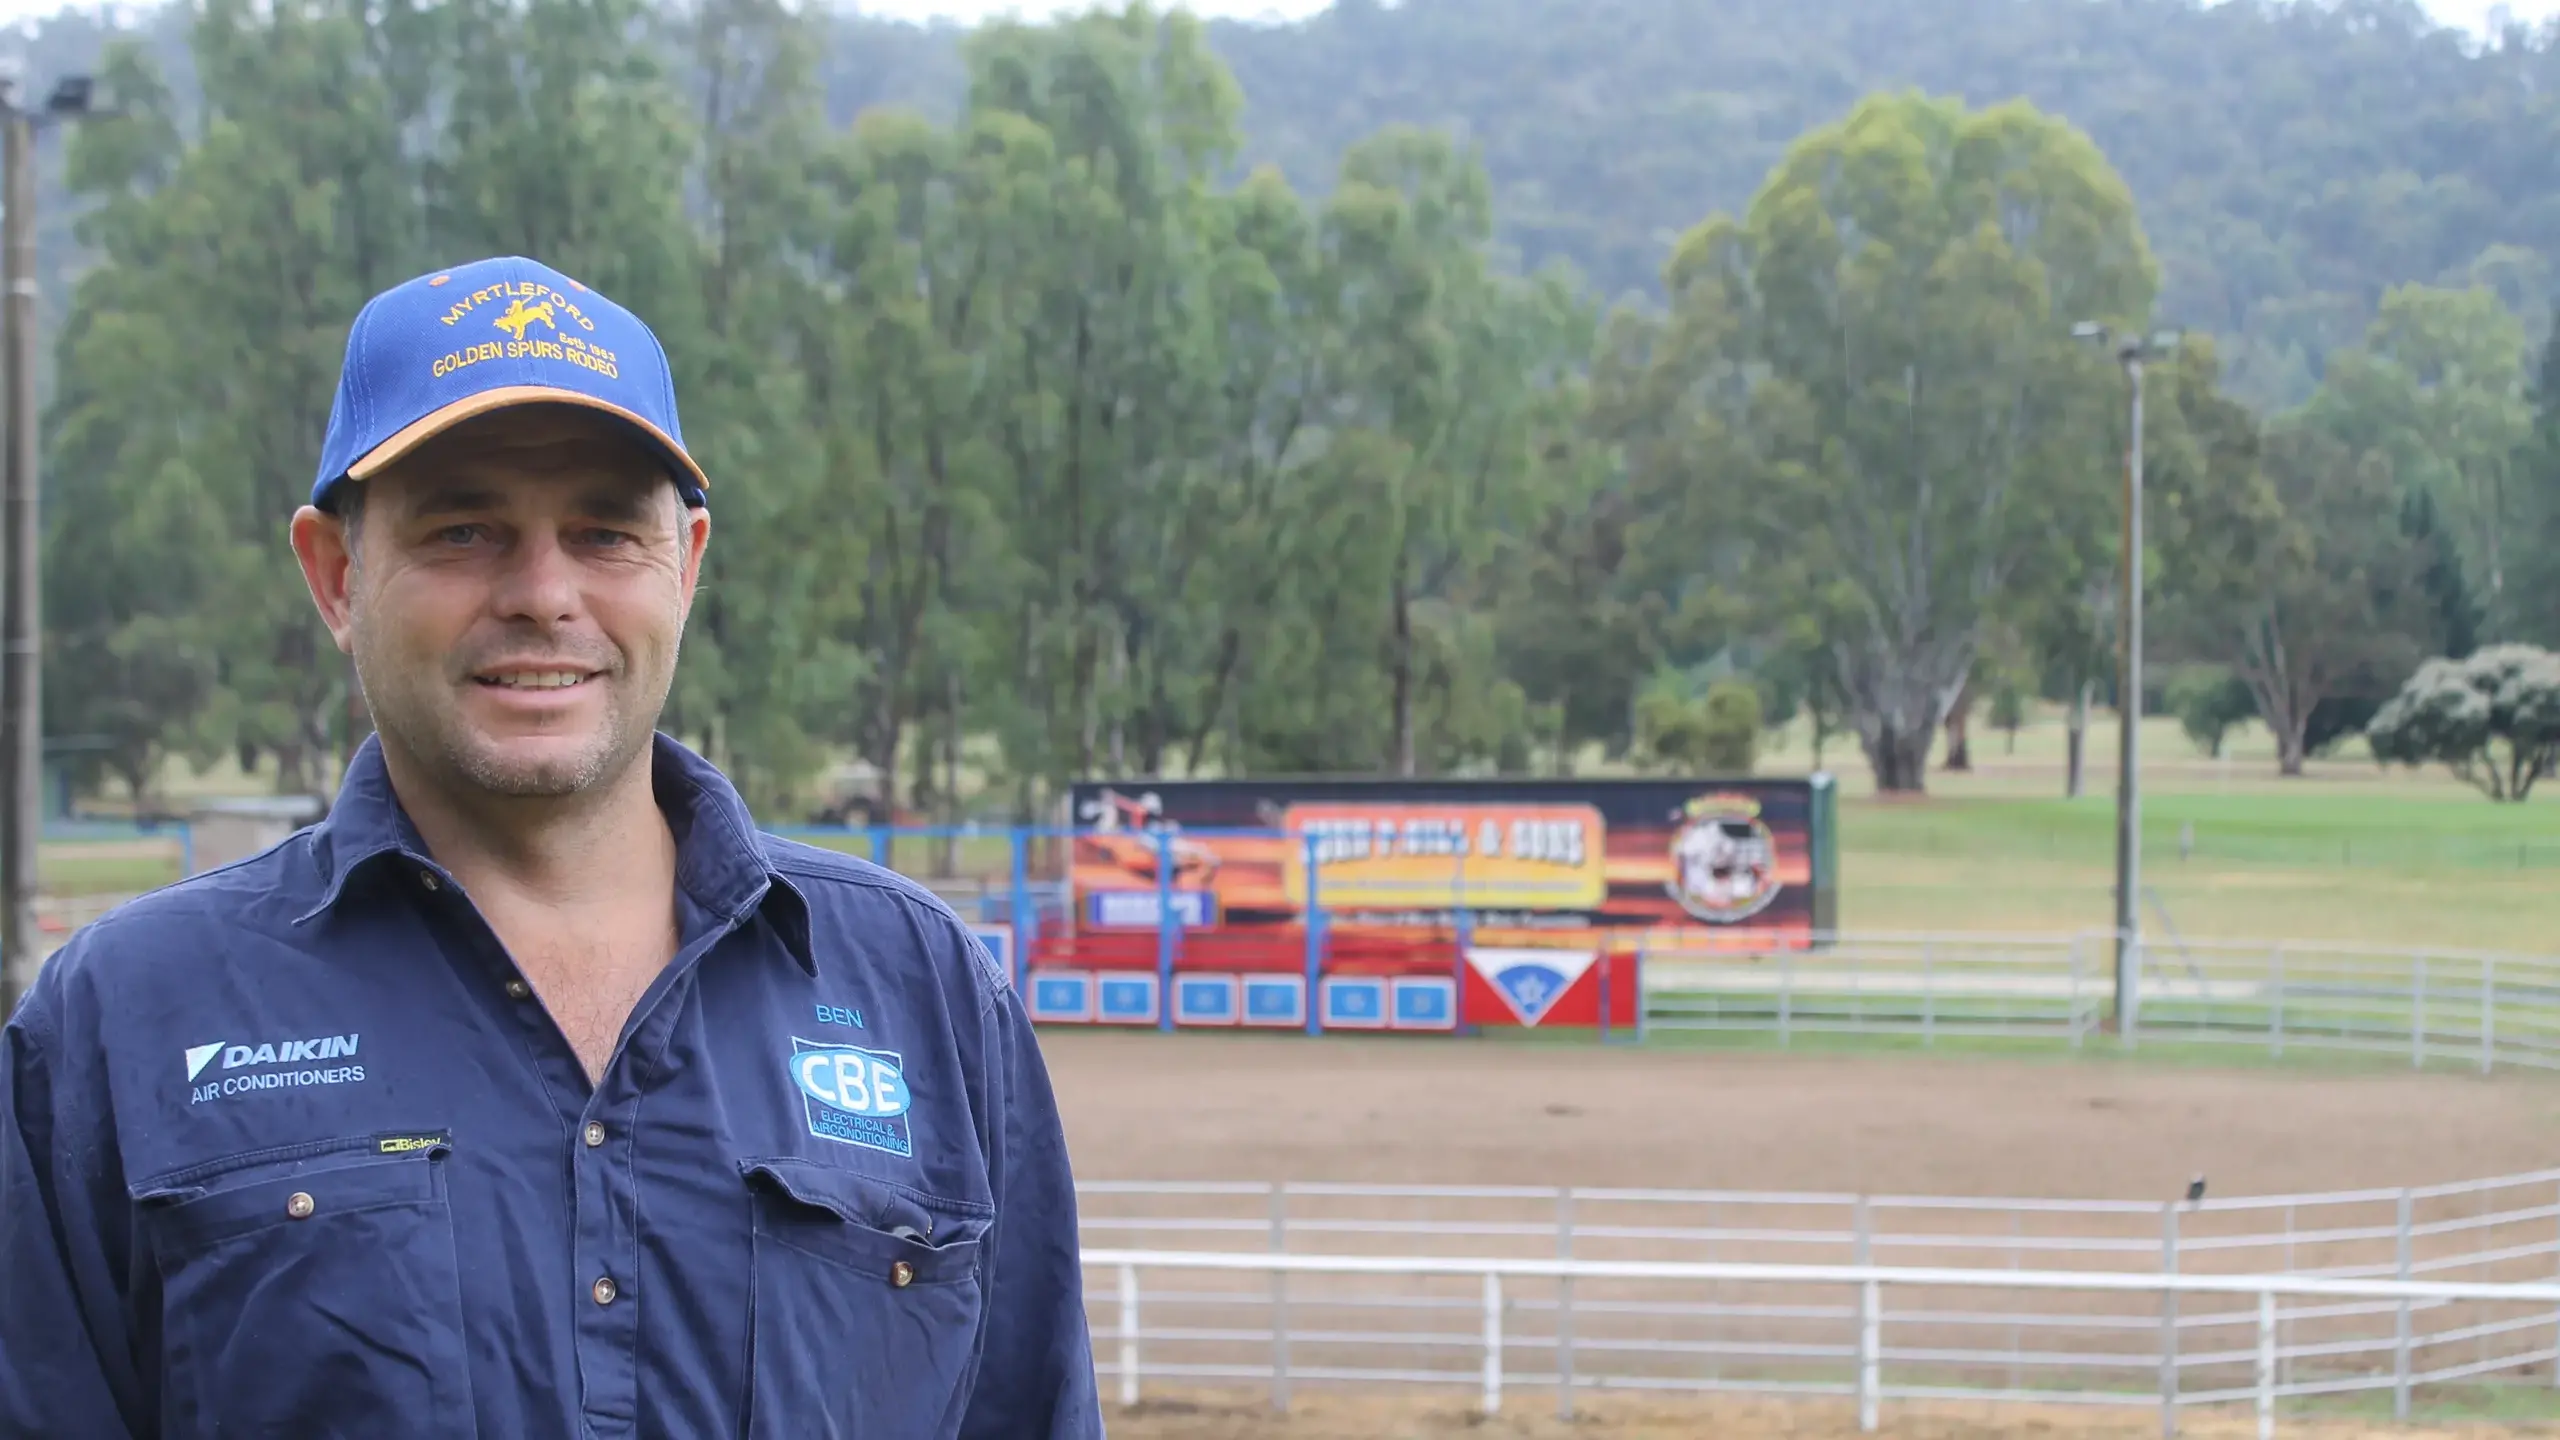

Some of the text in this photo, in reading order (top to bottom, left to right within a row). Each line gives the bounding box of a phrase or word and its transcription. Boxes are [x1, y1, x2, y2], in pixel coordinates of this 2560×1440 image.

[441, 281, 595, 332] MYRTLEFORD
[433, 339, 619, 380] GOLDEN SPURS RODEO
[816, 1004, 864, 1029] BEN
[222, 1033, 359, 1070] DAIKIN
[191, 1065, 366, 1105] AIR CONDITIONERS
[802, 1053, 901, 1113] CBE
[812, 1121, 908, 1152] AIRCONDITIONING
[821, 1110, 896, 1137] ELECTRICAL &
